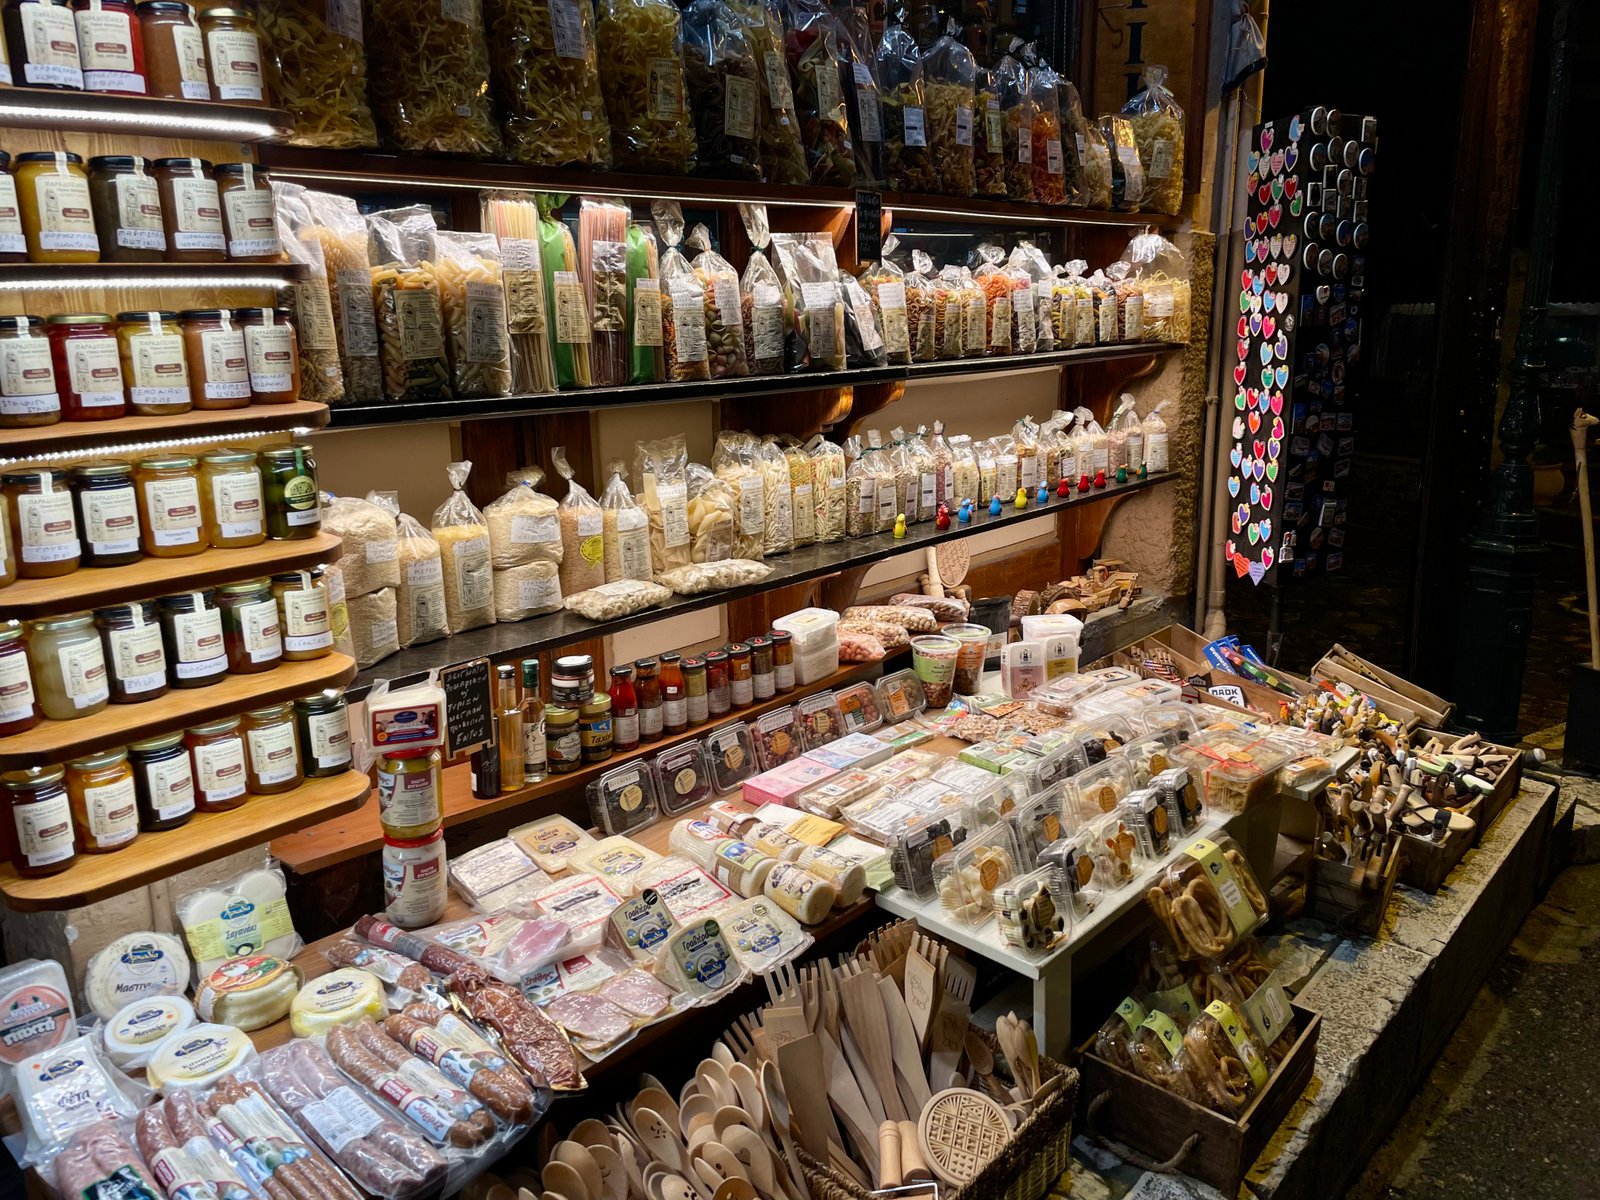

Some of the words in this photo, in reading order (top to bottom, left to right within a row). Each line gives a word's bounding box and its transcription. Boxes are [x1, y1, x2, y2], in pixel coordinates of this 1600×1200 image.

[1211, 688, 1238, 696] ΠΑΟΚ
[226, 924, 257, 940] Σαγανάκι
[682, 932, 709, 952] Γραβιέρα
